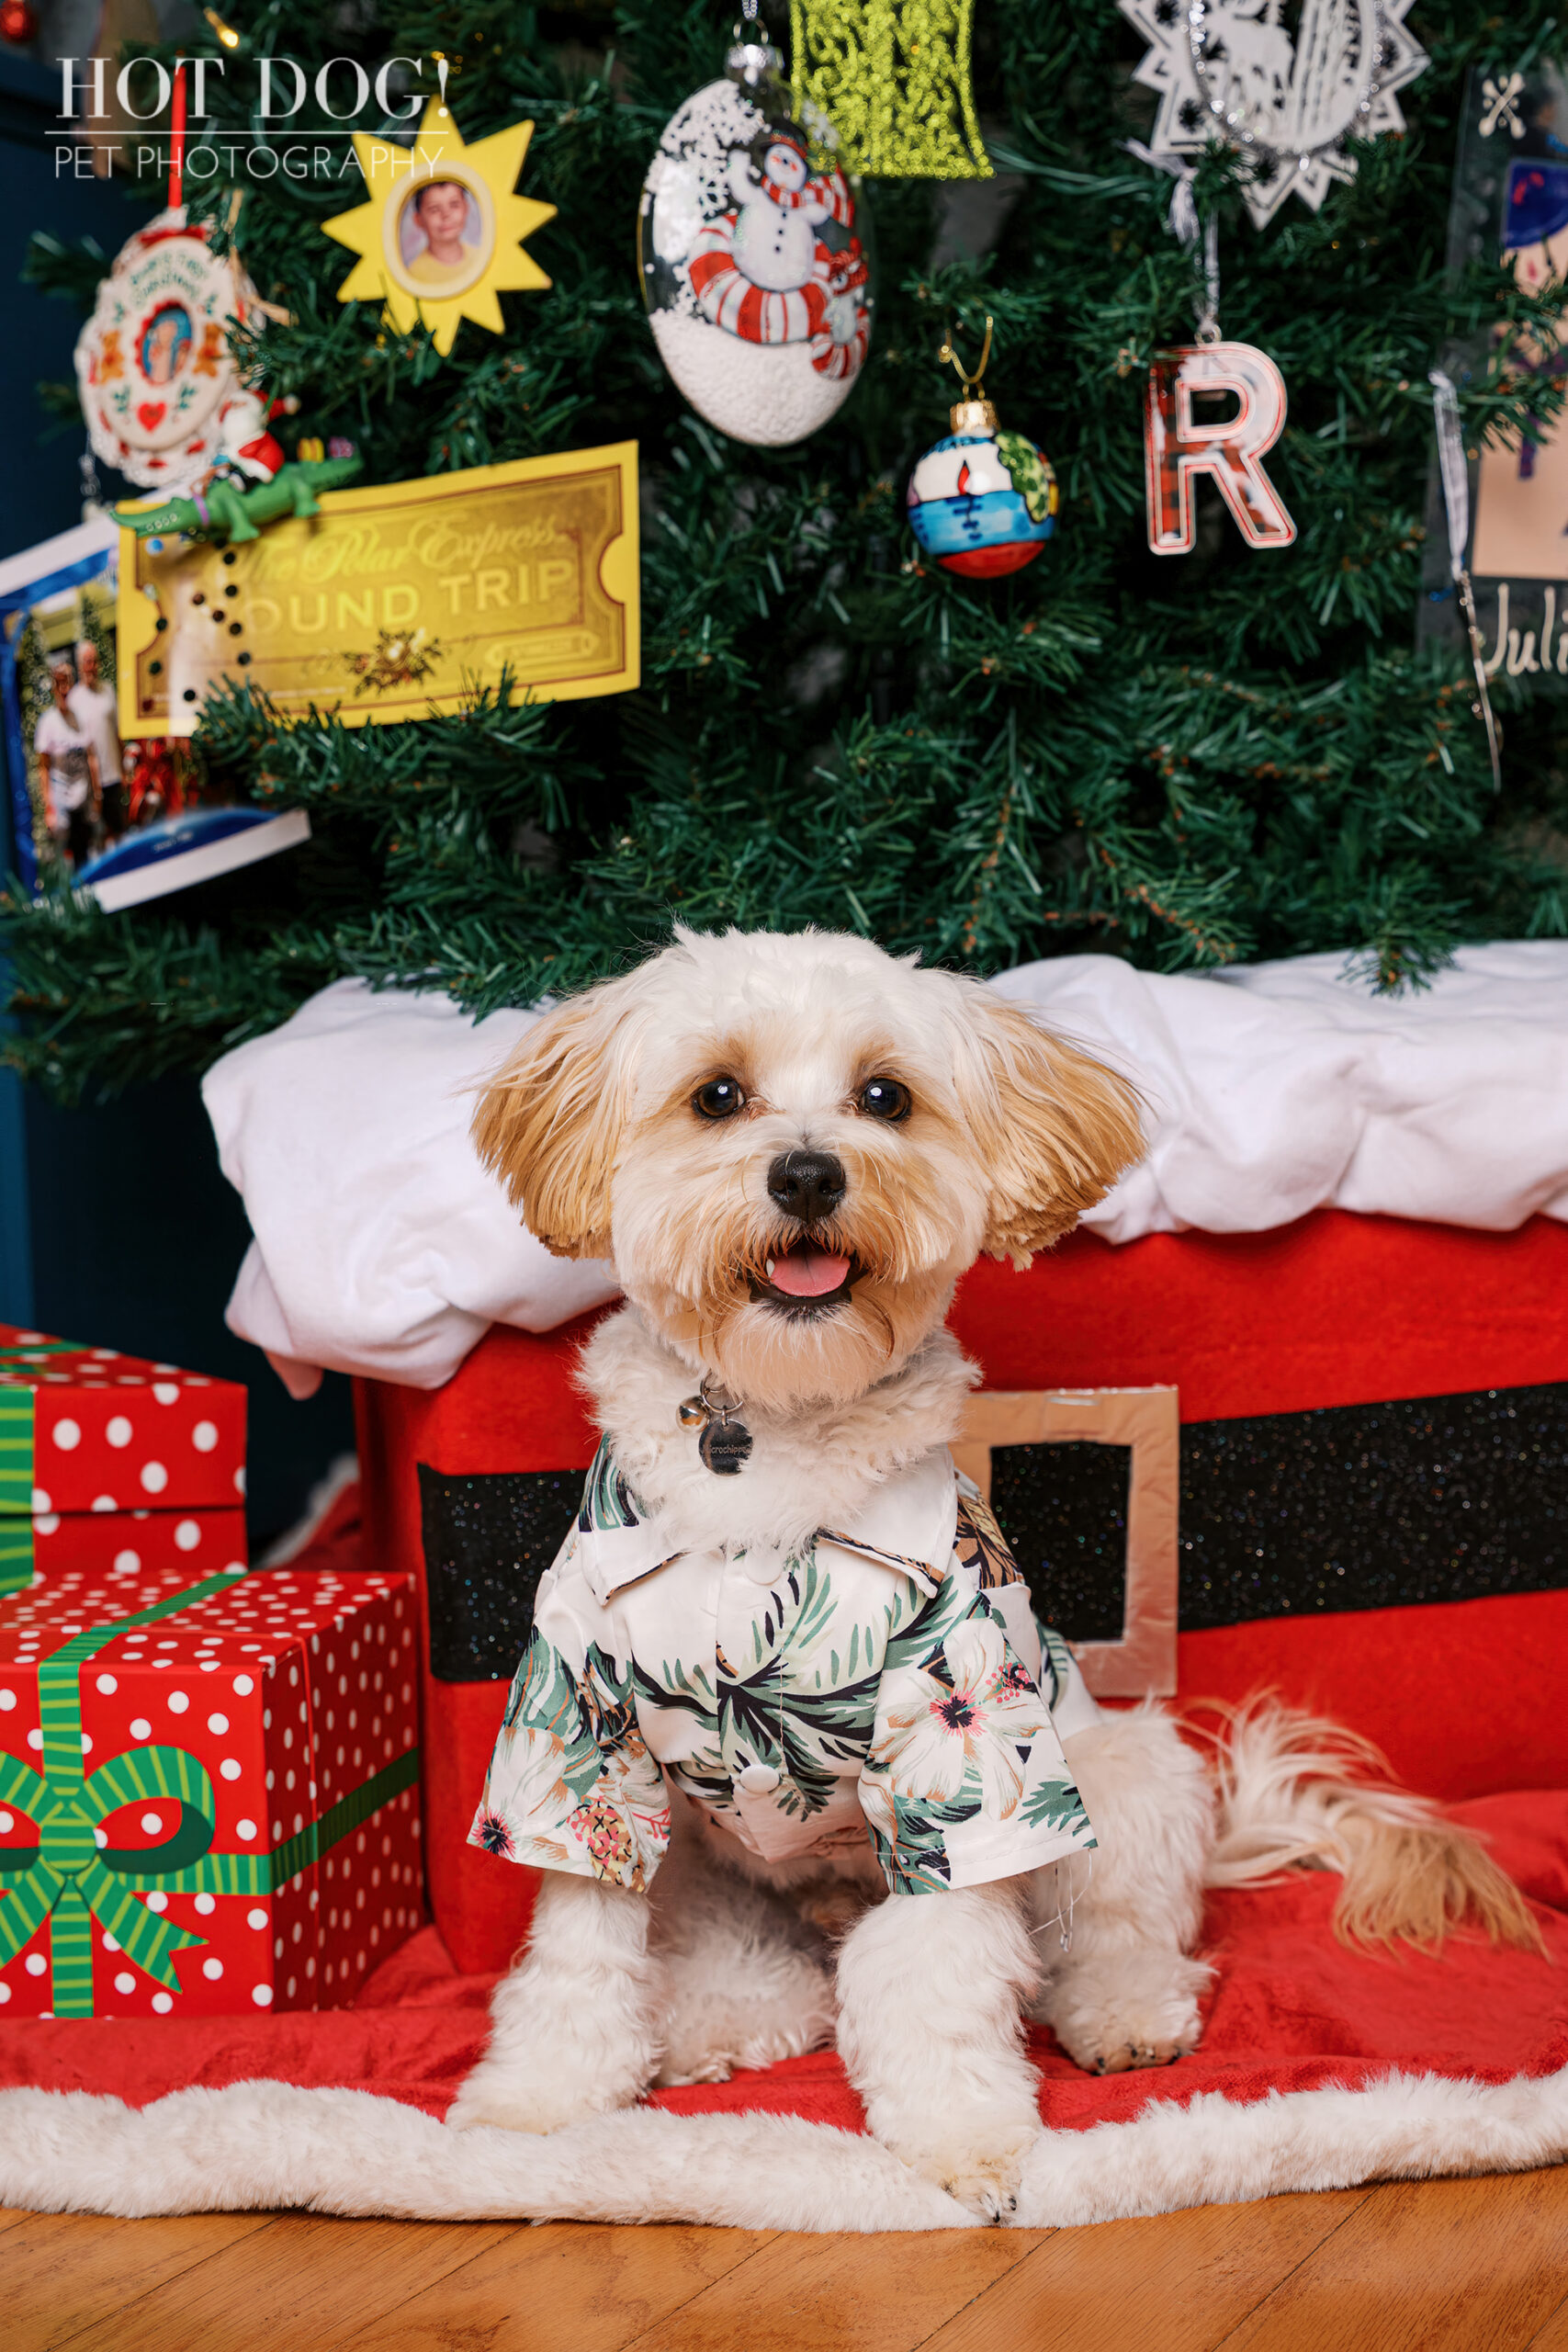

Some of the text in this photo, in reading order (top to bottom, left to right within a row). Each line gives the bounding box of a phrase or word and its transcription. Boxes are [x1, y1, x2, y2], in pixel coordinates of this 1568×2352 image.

[1145, 341, 1298, 555] R
[241, 558, 574, 637] OUND TRIP
